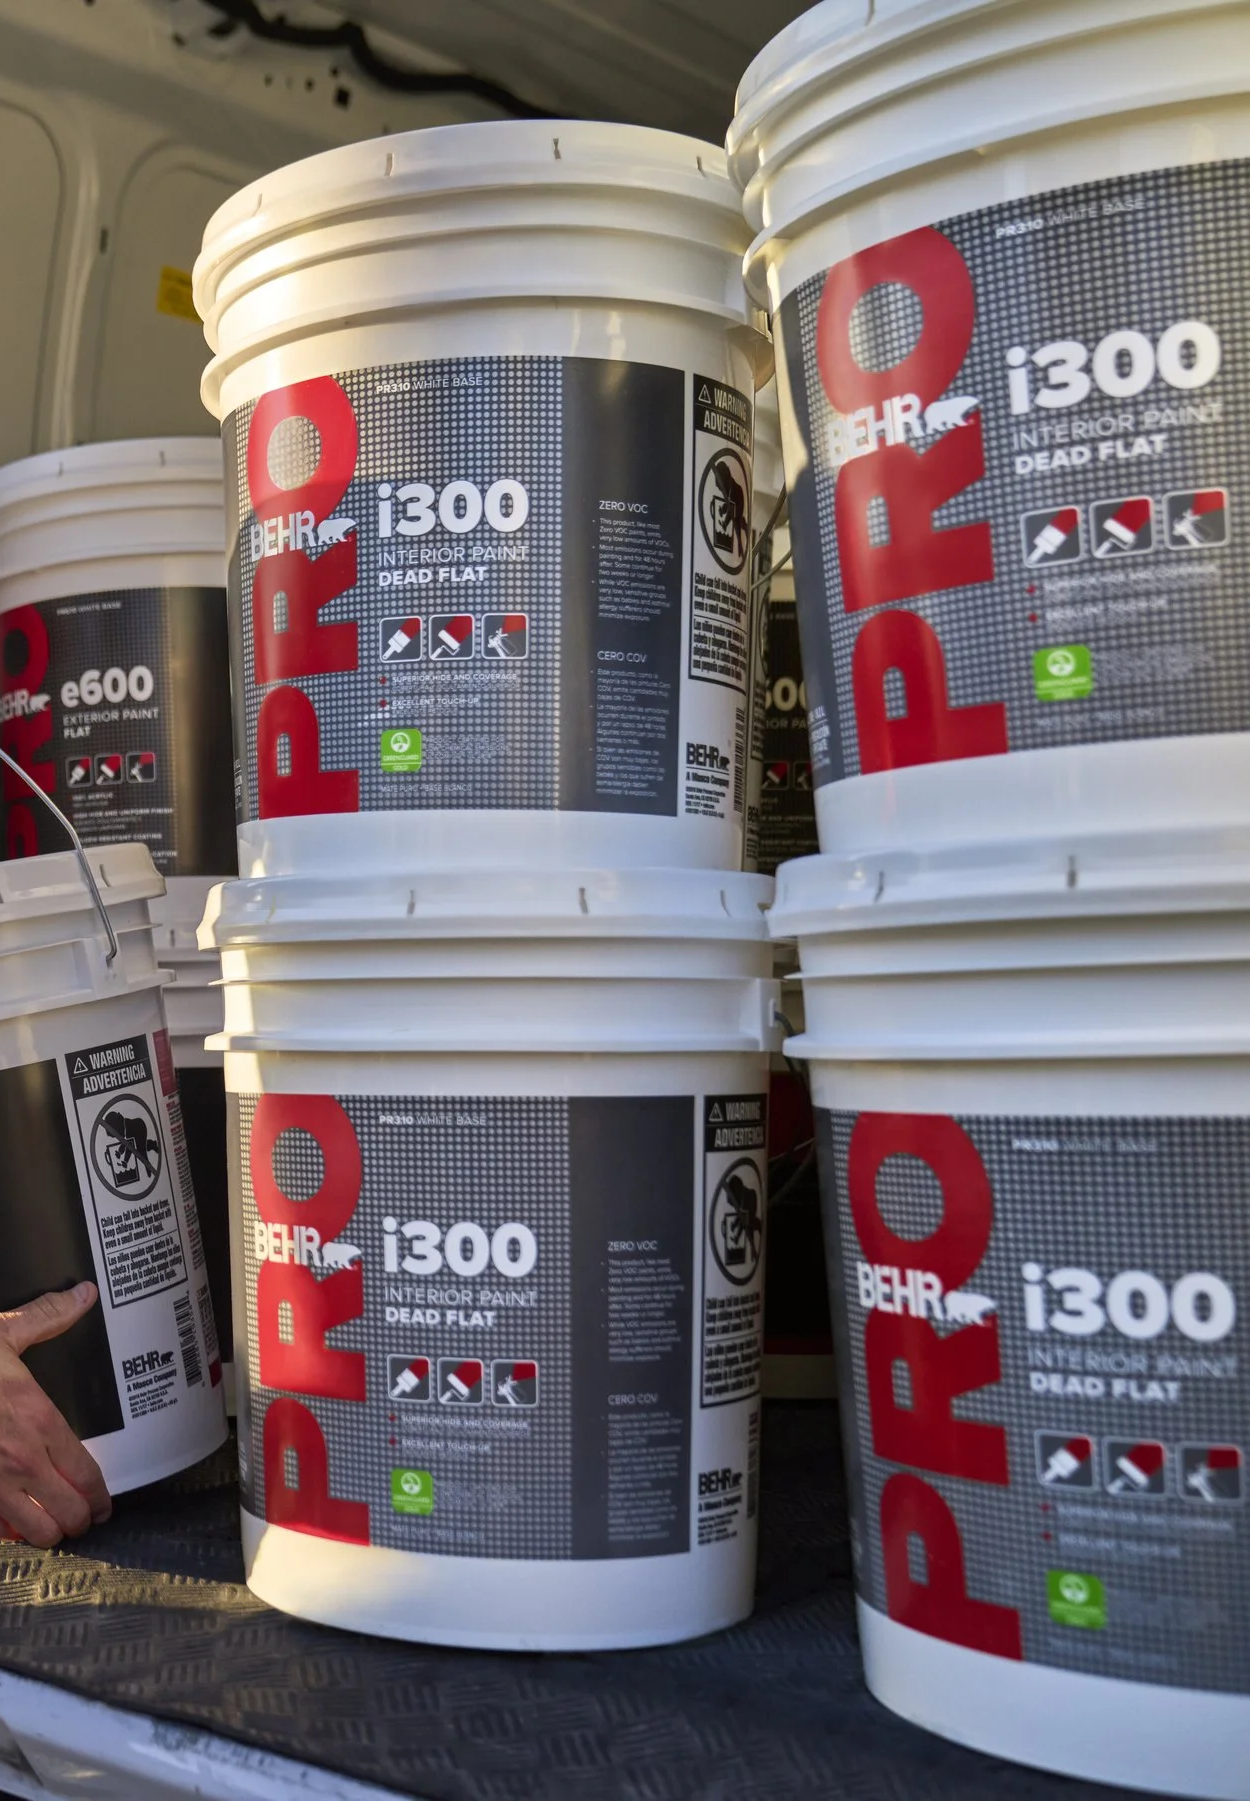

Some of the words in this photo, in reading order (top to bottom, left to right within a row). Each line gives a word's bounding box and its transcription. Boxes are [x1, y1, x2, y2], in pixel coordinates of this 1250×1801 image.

[1047, 208, 1097, 226] WHITE
[1102, 199, 1144, 216] BASE
[1006, 321, 1221, 415] i300
[376, 383, 410, 394] PR310
[412, 379, 449, 389] WHITE
[453, 377, 483, 386] BASE
[826, 393, 926, 468] BEHR
[1013, 415, 1134, 450] INTERIOR
[1144, 403, 1223, 430] PAINT
[1015, 446, 1090, 474] DEAD
[1099, 434, 1167, 460] FLAT
[378, 479, 529, 538] i300
[599, 500, 626, 511] ZERO
[628, 502, 648, 513] VOC
[816, 226, 1008, 775] PRO
[250, 509, 318, 562] BEHR
[378, 548, 465, 566] INTERIOR
[472, 546, 529, 561] PAINT
[379, 569, 432, 587] DEAD
[439, 567, 487, 582] FLAT
[247, 375, 359, 819] PRO
[597, 651, 625, 661] CERO
[626, 653, 647, 662] COV
[61, 665, 154, 708] e600
[392, 675, 430, 683] SUPERIOR
[63, 709, 119, 726] EXTERIOR
[122, 707, 159, 720] PAINT
[64, 726, 91, 739] FLAT
[686, 742, 720, 769] BEHR
[89, 1044, 135, 1070] WARNING
[83, 1063, 146, 1094] ADVERTENCIA
[379, 1116, 414, 1125] PR310
[416, 1115, 452, 1125] WHITE
[457, 1116, 486, 1126] BASE
[101, 1216, 114, 1228] Child
[114, 1215, 123, 1224] can
[131, 1208, 139, 1219] into
[139, 1203, 152, 1216] bucket
[102, 1229, 115, 1239] Keep
[116, 1223, 134, 1235] children
[105, 1239, 117, 1249] even
[121, 1232, 133, 1245] small
[254, 1221, 322, 1267] BEHR
[382, 1216, 537, 1277] i300
[608, 1241, 634, 1252] ZERO
[636, 1240, 658, 1251] VOC
[385, 1286, 473, 1306] INTERIOR
[480, 1290, 537, 1308] PAINT
[857, 1260, 945, 1322] BEHR
[1021, 1262, 1236, 1342] i300
[250, 1093, 370, 1547] PRO
[385, 1307, 441, 1324] DEAD
[446, 1310, 495, 1327] FLAT
[122, 1350, 161, 1379] BEHR
[1027, 1348, 1148, 1374] INTERIOR
[1156, 1354, 1237, 1378] PAINT
[127, 1384, 131, 1392] A
[132, 1378, 153, 1391] Masco
[154, 1369, 177, 1383] Company
[849, 1112, 1022, 1661] PRO
[1029, 1371, 1105, 1397] DEAD
[1111, 1377, 1180, 1401] FLAT
[607, 1394, 635, 1406] CERO
[637, 1393, 658, 1405] COV
[698, 1467, 731, 1496] BEHR
